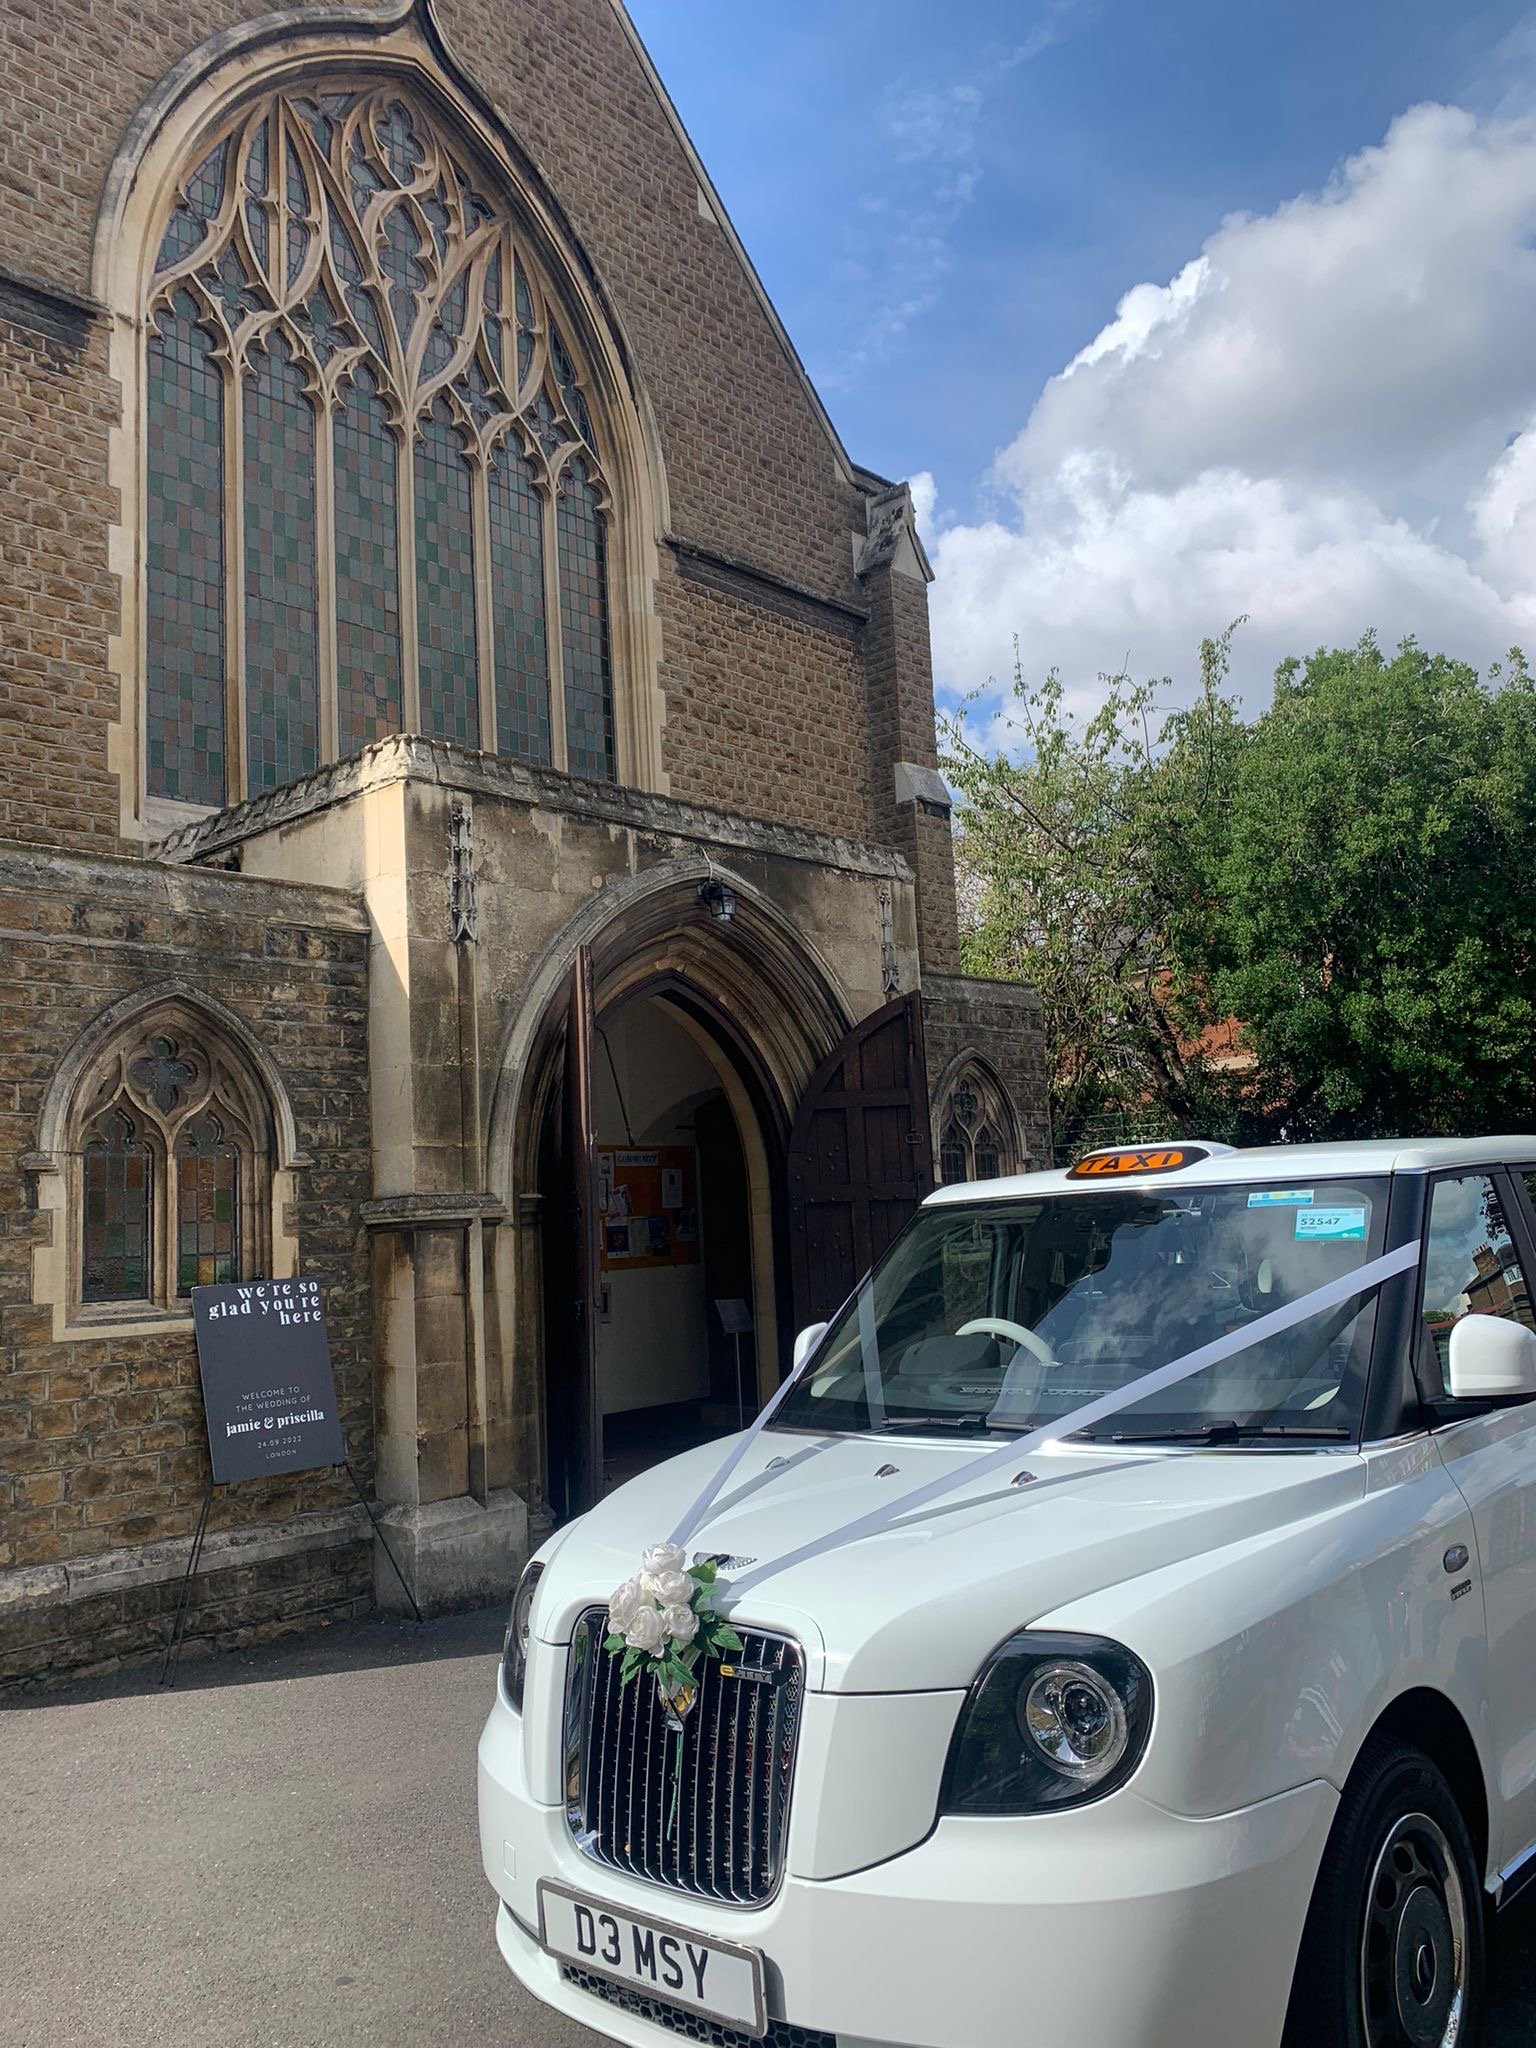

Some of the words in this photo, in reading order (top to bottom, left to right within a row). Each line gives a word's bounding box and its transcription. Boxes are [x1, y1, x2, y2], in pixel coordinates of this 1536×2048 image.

[1085, 1153, 1173, 1171] TAXI
[1300, 1217, 1341, 1226] 52547
[237, 1282, 291, 1300] we're
[298, 1281, 318, 1294] so
[208, 1299, 252, 1320] glad
[259, 1294, 320, 1315] you're
[279, 1310, 321, 1325] here
[241, 1387, 285, 1401] WELCOME
[288, 1385, 300, 1394] TO
[235, 1403, 254, 1413] THE
[256, 1397, 298, 1410] WEDDING
[300, 1394, 311, 1404] OF
[225, 1418, 261, 1437] jamie
[263, 1416, 274, 1430] &
[277, 1409, 325, 1429] priscilla
[265, 1449, 297, 1460] LONDON
[573, 1903, 621, 1967] D3
[631, 1924, 709, 2000] MSY
